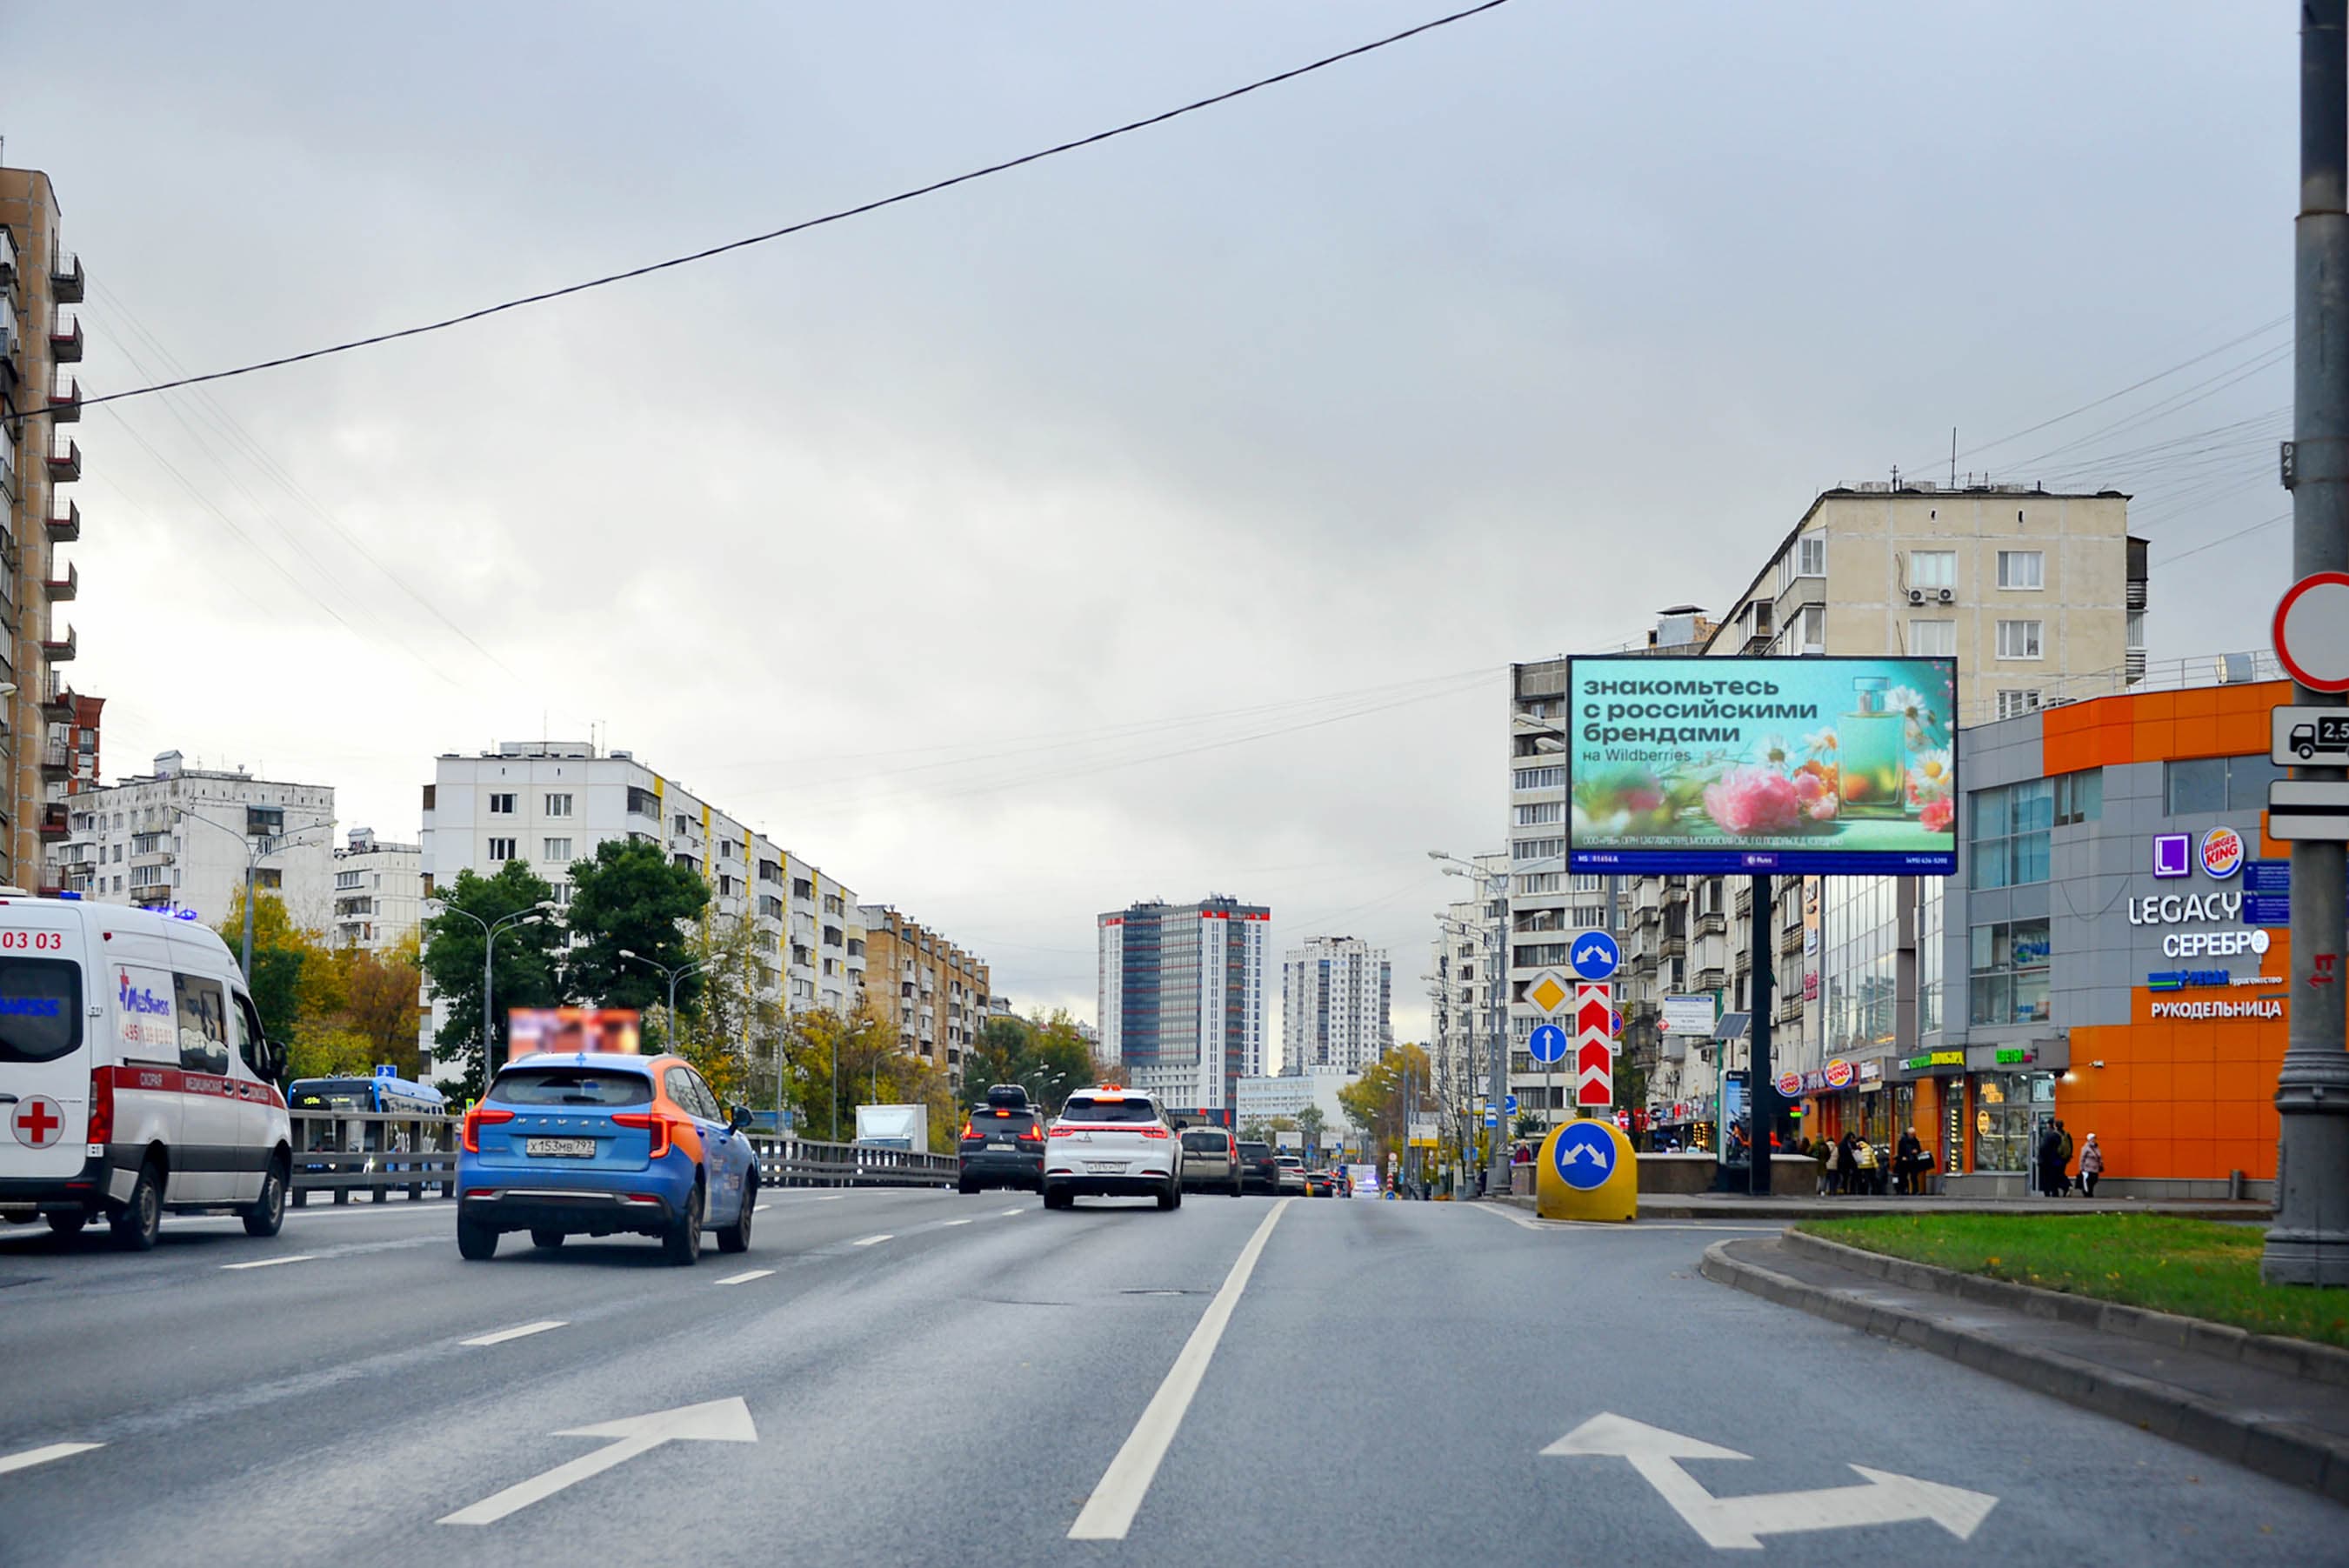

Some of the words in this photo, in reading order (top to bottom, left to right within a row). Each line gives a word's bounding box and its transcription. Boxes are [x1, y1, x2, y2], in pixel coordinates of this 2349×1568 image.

[1583, 679, 1779, 696] знакомьтесь
[1583, 703, 1600, 719] с
[1607, 698, 1818, 723] российскими
[1583, 723, 1739, 745] брендами
[1583, 751, 1601, 762] на
[1605, 748, 1692, 762] Wildberries
[2205, 835, 2237, 854] BURGER
[2206, 843, 2238, 867] KING
[2128, 891, 2243, 925] LEGACY
[3, 931, 28, 949] 03
[36, 932, 62, 950] 03
[2163, 929, 2271, 958] СЕРЕБРО
[2151, 1000, 2283, 1019] РУКОДЕЛЬНИЦА
[1828, 1070, 1851, 1082] KING
[1780, 1081, 1799, 1091] KING
